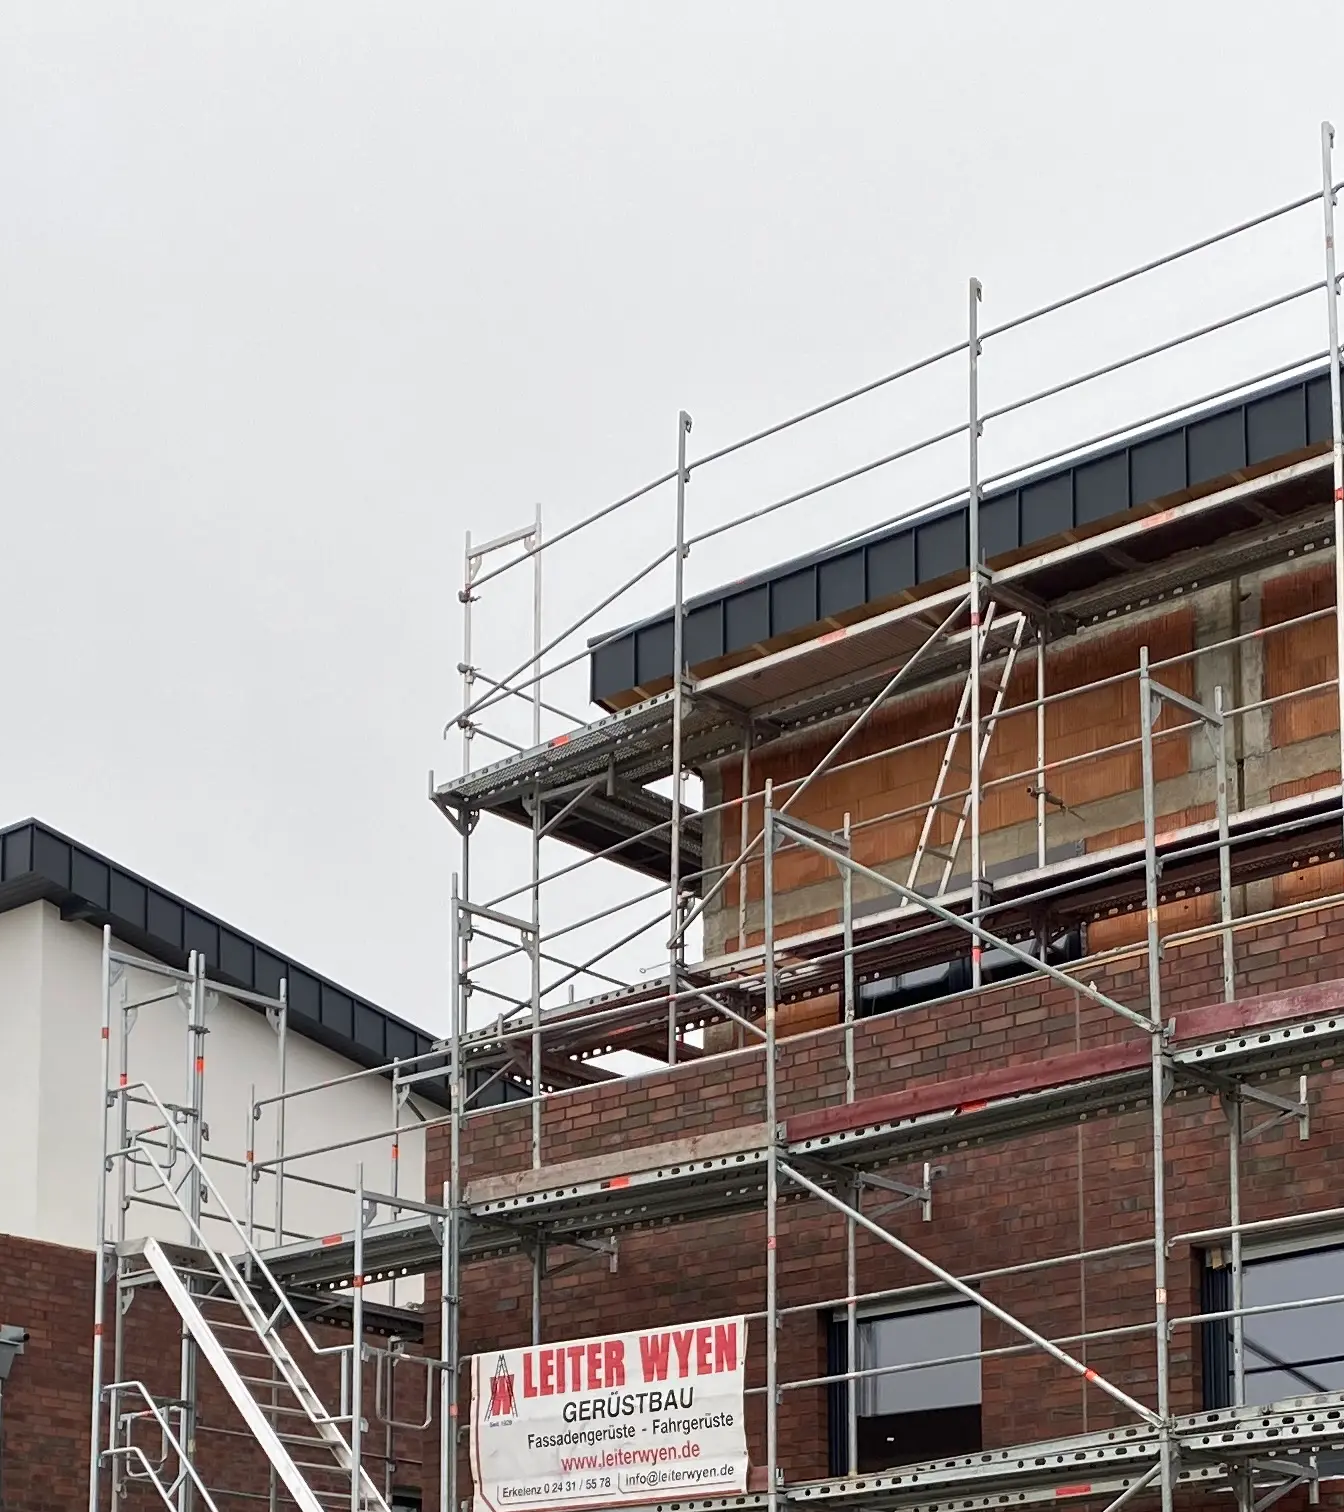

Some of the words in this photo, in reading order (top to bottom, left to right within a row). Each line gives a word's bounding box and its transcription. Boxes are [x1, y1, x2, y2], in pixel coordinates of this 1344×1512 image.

[523, 1340, 625, 1399] LEITER
[639, 1323, 737, 1383] WYEN
[563, 1387, 694, 1423] GERÜSTBAU
[528, 1424, 636, 1449] Fassadengerüste
[652, 1412, 734, 1436] Fahrgerüste
[561, 1440, 701, 1472] www.leiterwyen.de
[502, 1485, 542, 1498] Erkelenz
[544, 1483, 550, 1494] 0
[552, 1482, 563, 1493] 24
[565, 1481, 576, 1492] 31
[586, 1478, 597, 1490] 55
[599, 1476, 611, 1488] 78
[625, 1463, 735, 1487] info@leiterwyen.de
